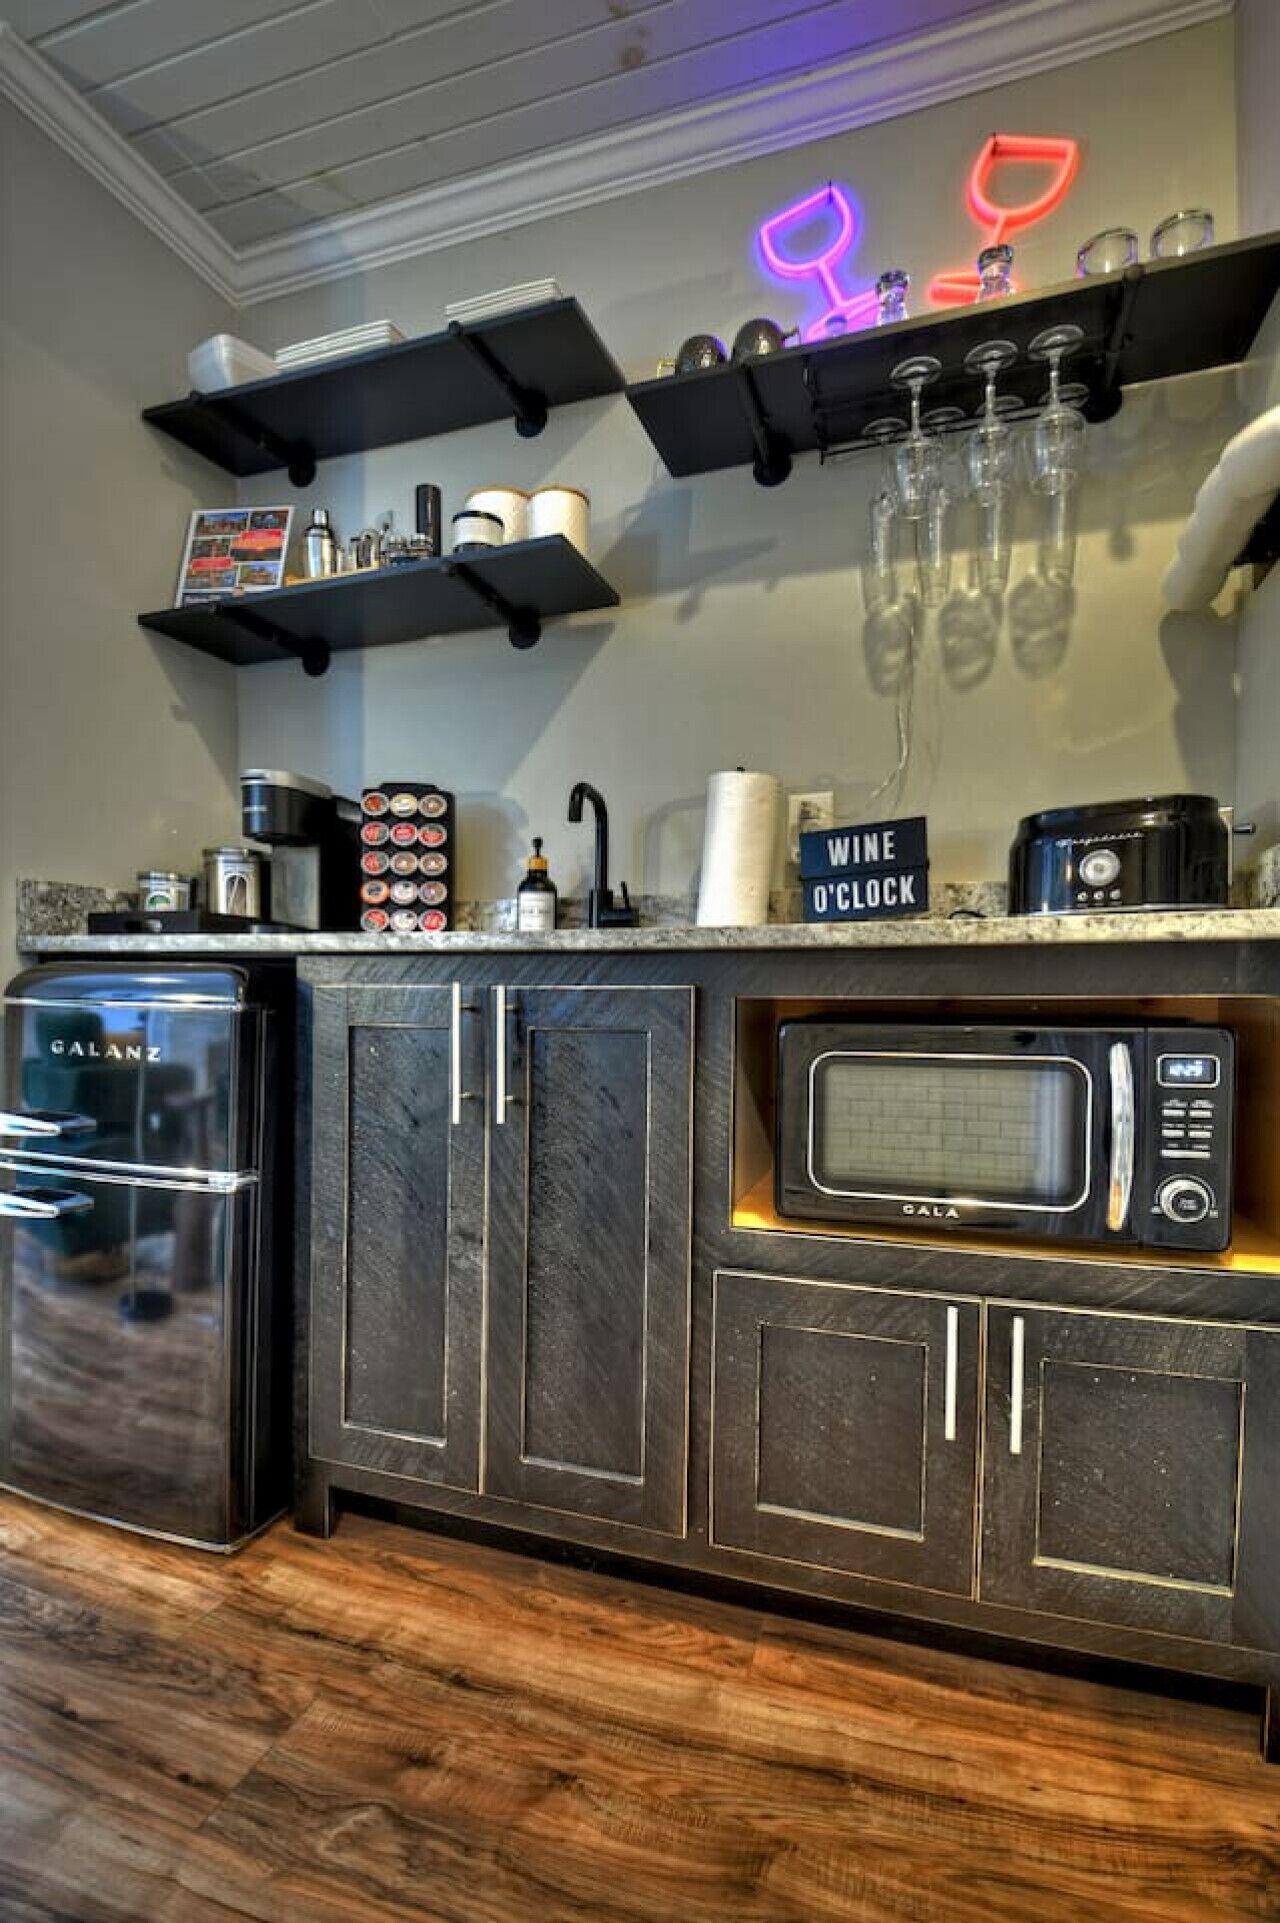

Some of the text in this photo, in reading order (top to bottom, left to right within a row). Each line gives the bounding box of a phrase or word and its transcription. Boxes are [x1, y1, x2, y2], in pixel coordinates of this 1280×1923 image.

[827, 831, 896, 866] WINE
[813, 875, 916, 913] O'CLOCK
[51, 1039, 161, 1063] GALANZ
